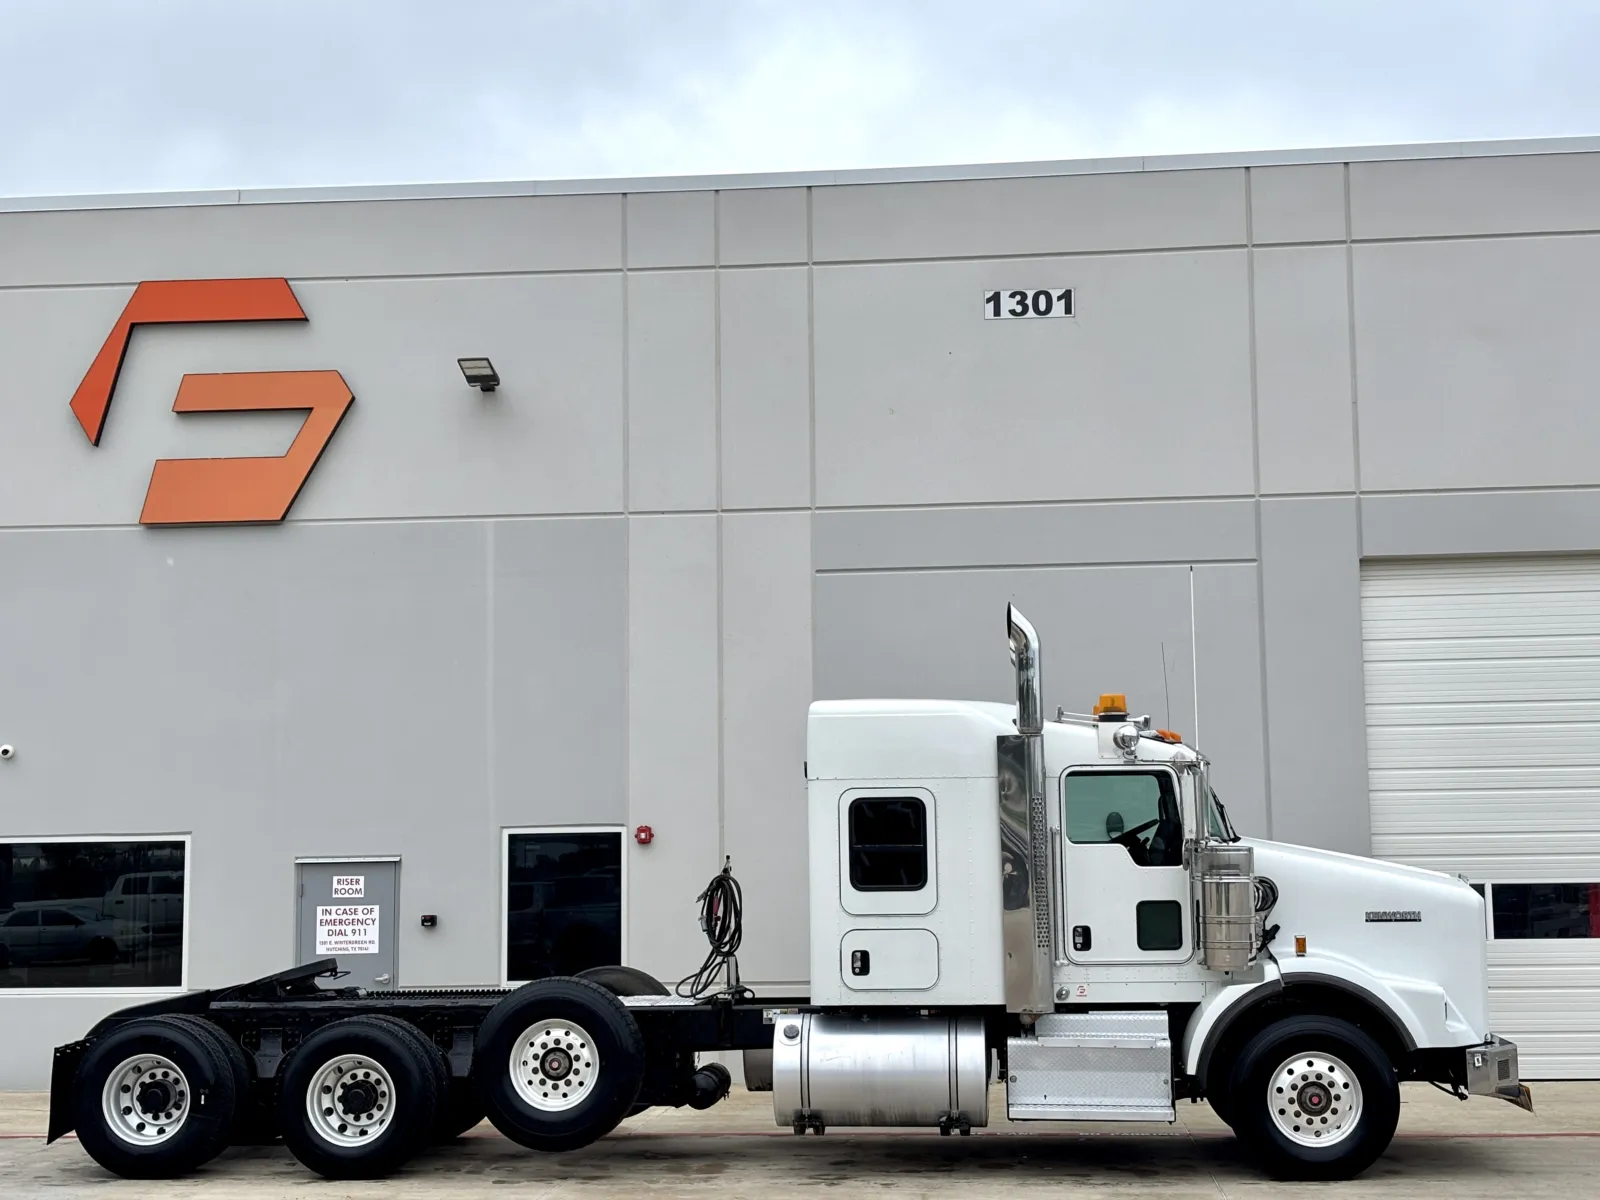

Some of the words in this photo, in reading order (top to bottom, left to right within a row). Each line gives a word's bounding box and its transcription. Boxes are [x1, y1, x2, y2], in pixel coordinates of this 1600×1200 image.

[985, 289, 1072, 317] 1301
[336, 878, 361, 886] RISER
[334, 887, 363, 896] ROOM
[321, 908, 332, 916] IN
[335, 907, 359, 916] CASE
[361, 907, 375, 916] OF
[1365, 910, 1421, 922] KENWORTH
[319, 918, 376, 927] EMERGENCY
[327, 928, 348, 937] DIAL
[351, 928, 367, 937] 911
